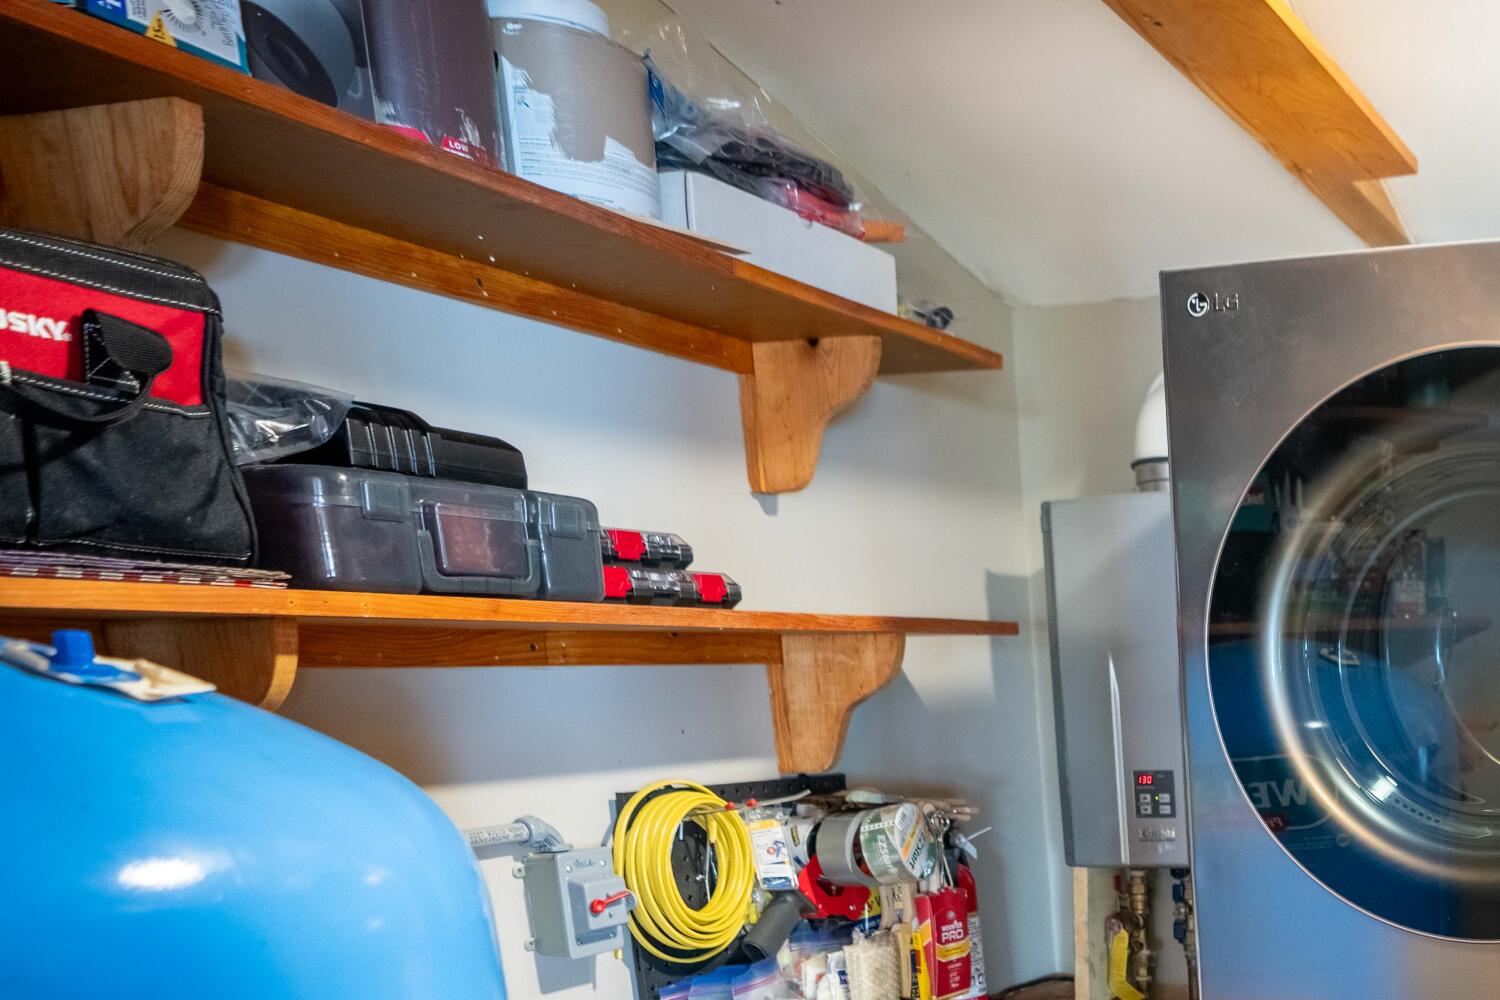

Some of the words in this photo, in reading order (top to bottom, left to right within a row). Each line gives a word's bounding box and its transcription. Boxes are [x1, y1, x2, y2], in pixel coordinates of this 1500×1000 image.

[448, 140, 469, 153] LOW
[1138, 775, 1153, 785] 130
[941, 929, 964, 943] PRO
